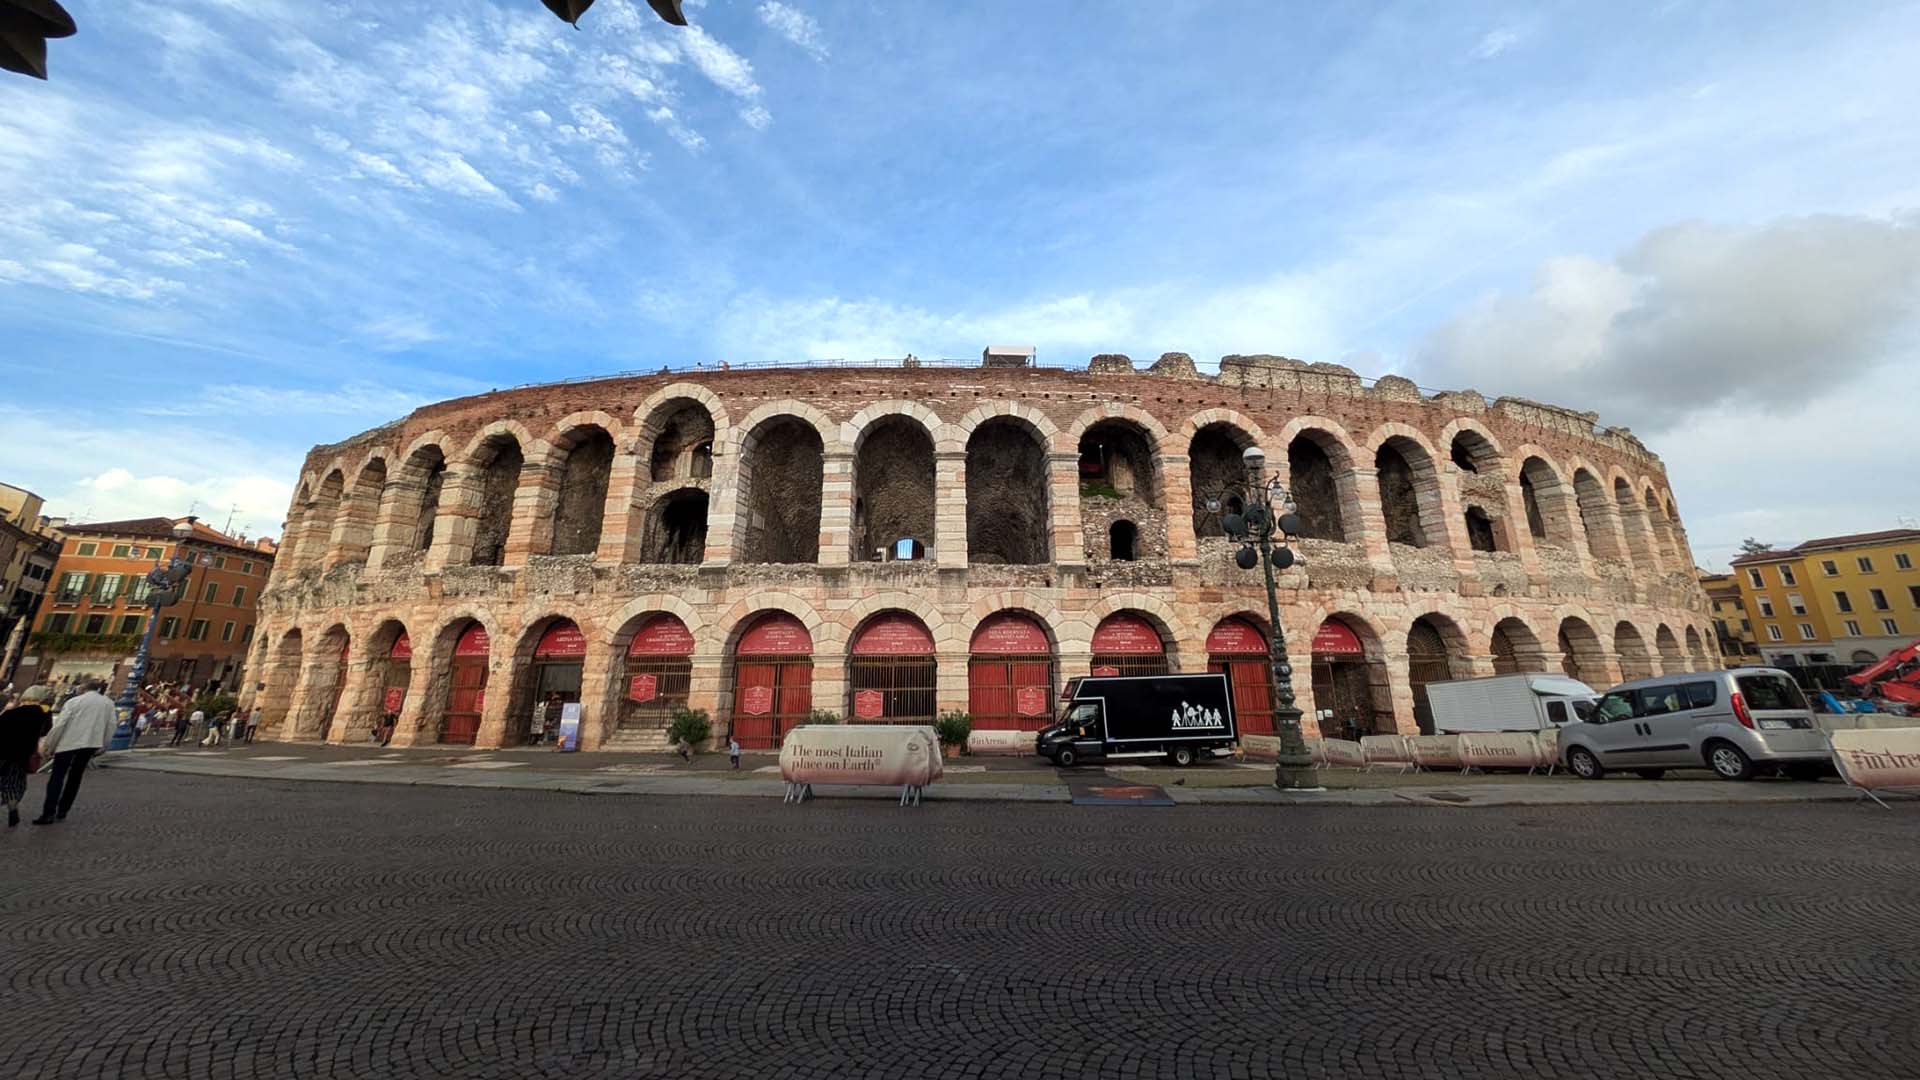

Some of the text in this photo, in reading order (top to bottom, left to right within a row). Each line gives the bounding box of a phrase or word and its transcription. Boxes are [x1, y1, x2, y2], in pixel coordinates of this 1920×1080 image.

[790, 743, 884, 759] The most Italian
[1463, 744, 1516, 757] #inArena
[792, 757, 823, 772] place
[825, 762, 840, 771] on
